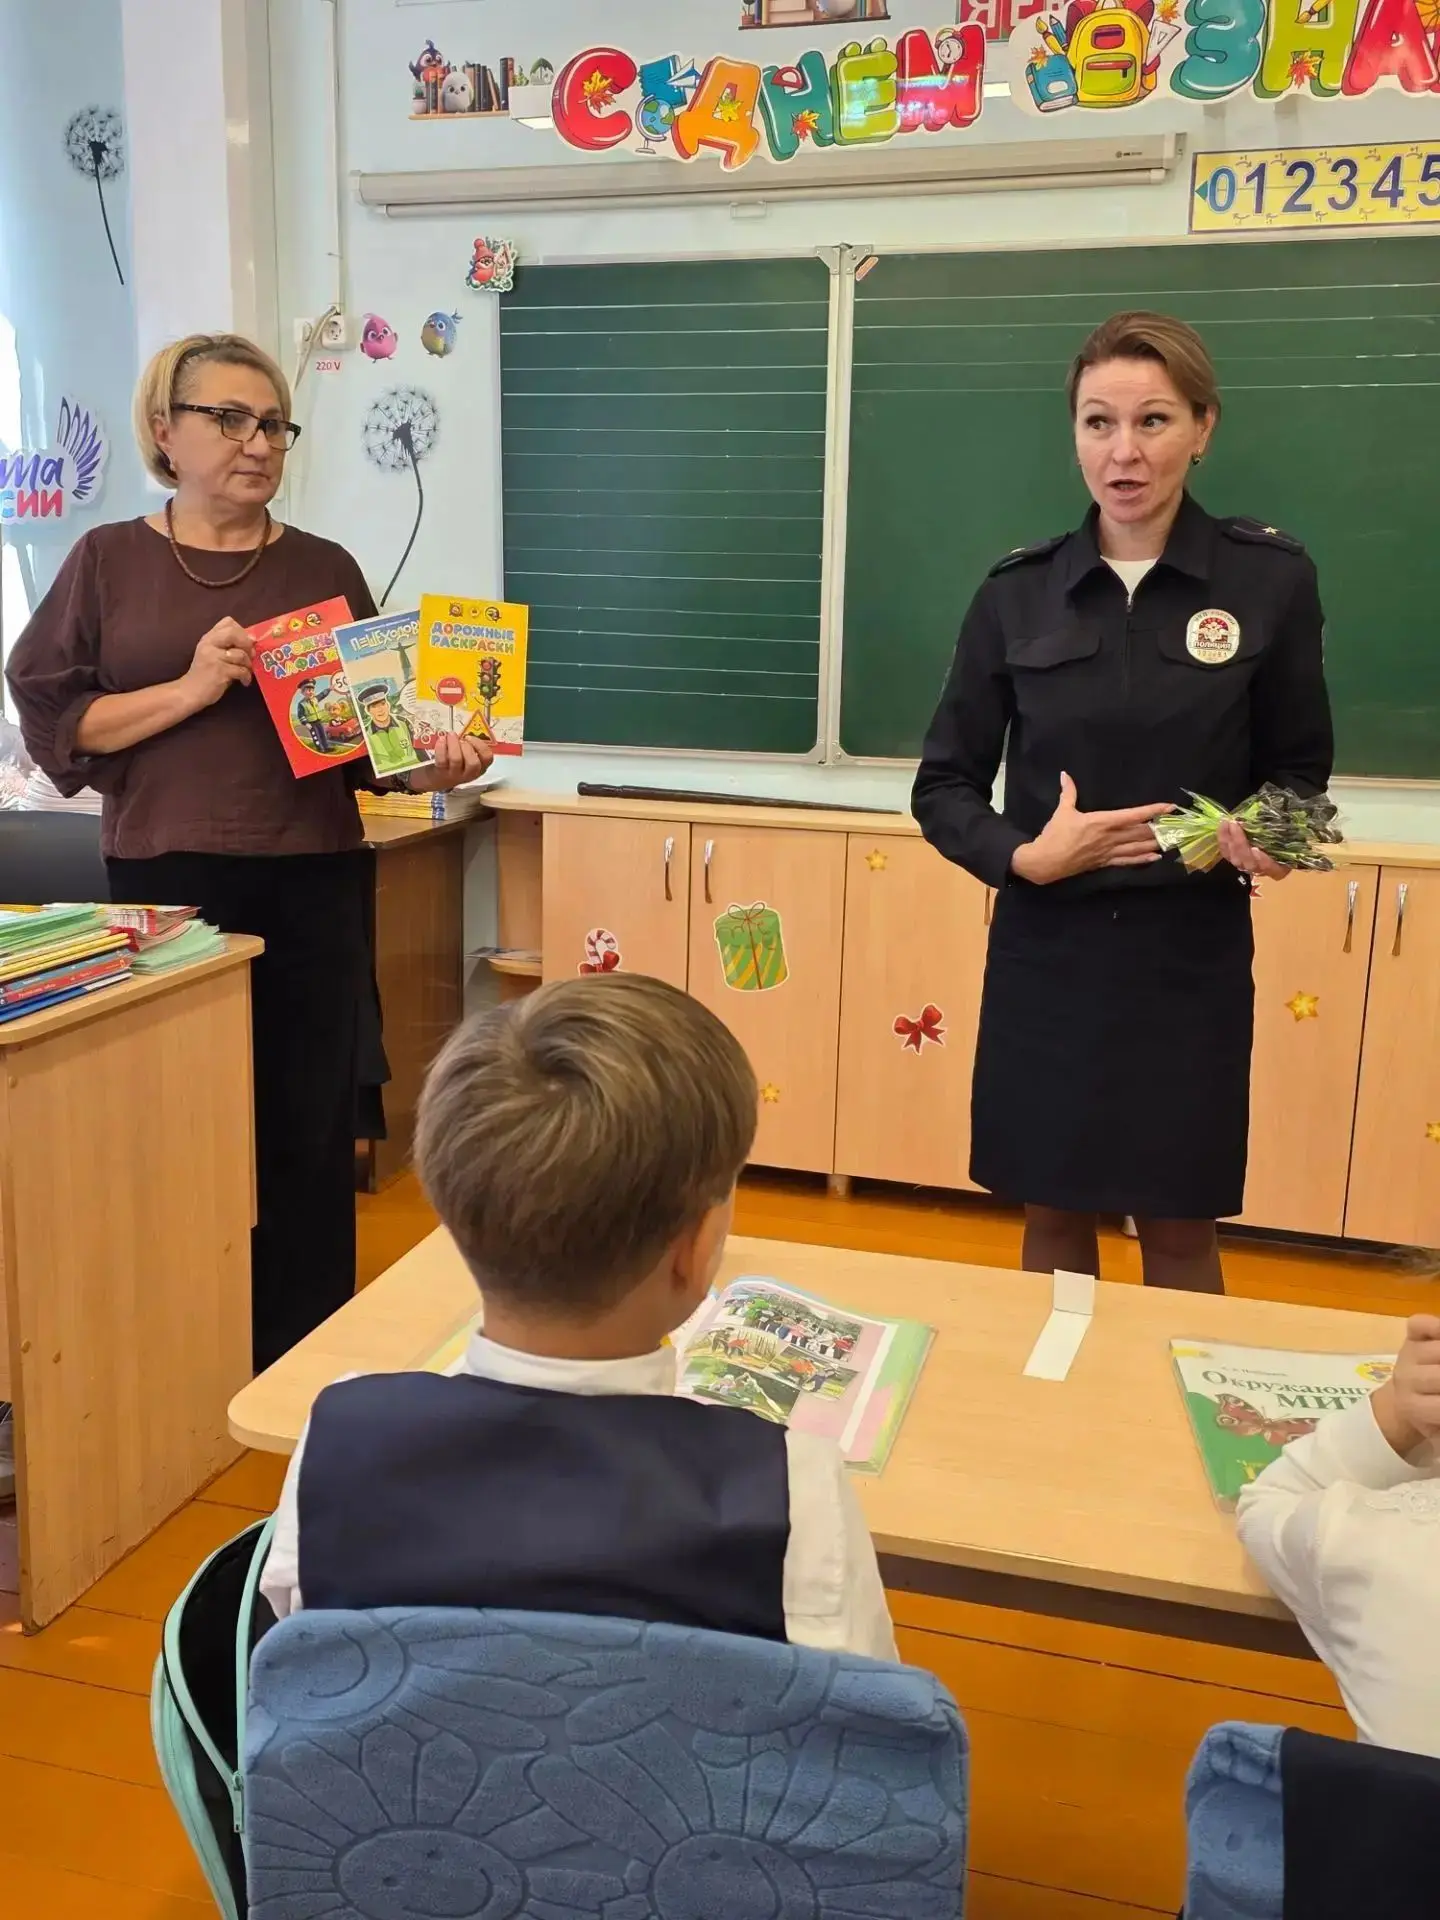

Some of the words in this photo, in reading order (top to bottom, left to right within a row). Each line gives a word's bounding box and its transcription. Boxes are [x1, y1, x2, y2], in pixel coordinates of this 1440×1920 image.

[552, 46, 638, 150] С
[1169, 0, 1440, 98] ЗНА
[1208, 167, 1236, 213] 0
[1245, 162, 1266, 214] 1
[1281, 160, 1315, 213] 2
[1327, 158, 1358, 211] 3
[1370, 155, 1404, 209] 4
[315, 361, 332, 371] 220
[333, 361, 341, 371] V
[350, 619, 420, 652] ПЕШЕХОДОВ
[430, 620, 516, 642] ДОРОЖНЫЕ
[430, 634, 516, 656] РАСКРАСКИ
[260, 632, 334, 672] ДОРОЖНЫ
[274, 646, 338, 680] АЛФАВИ
[1202, 1370, 1370, 1397] Окружающ
